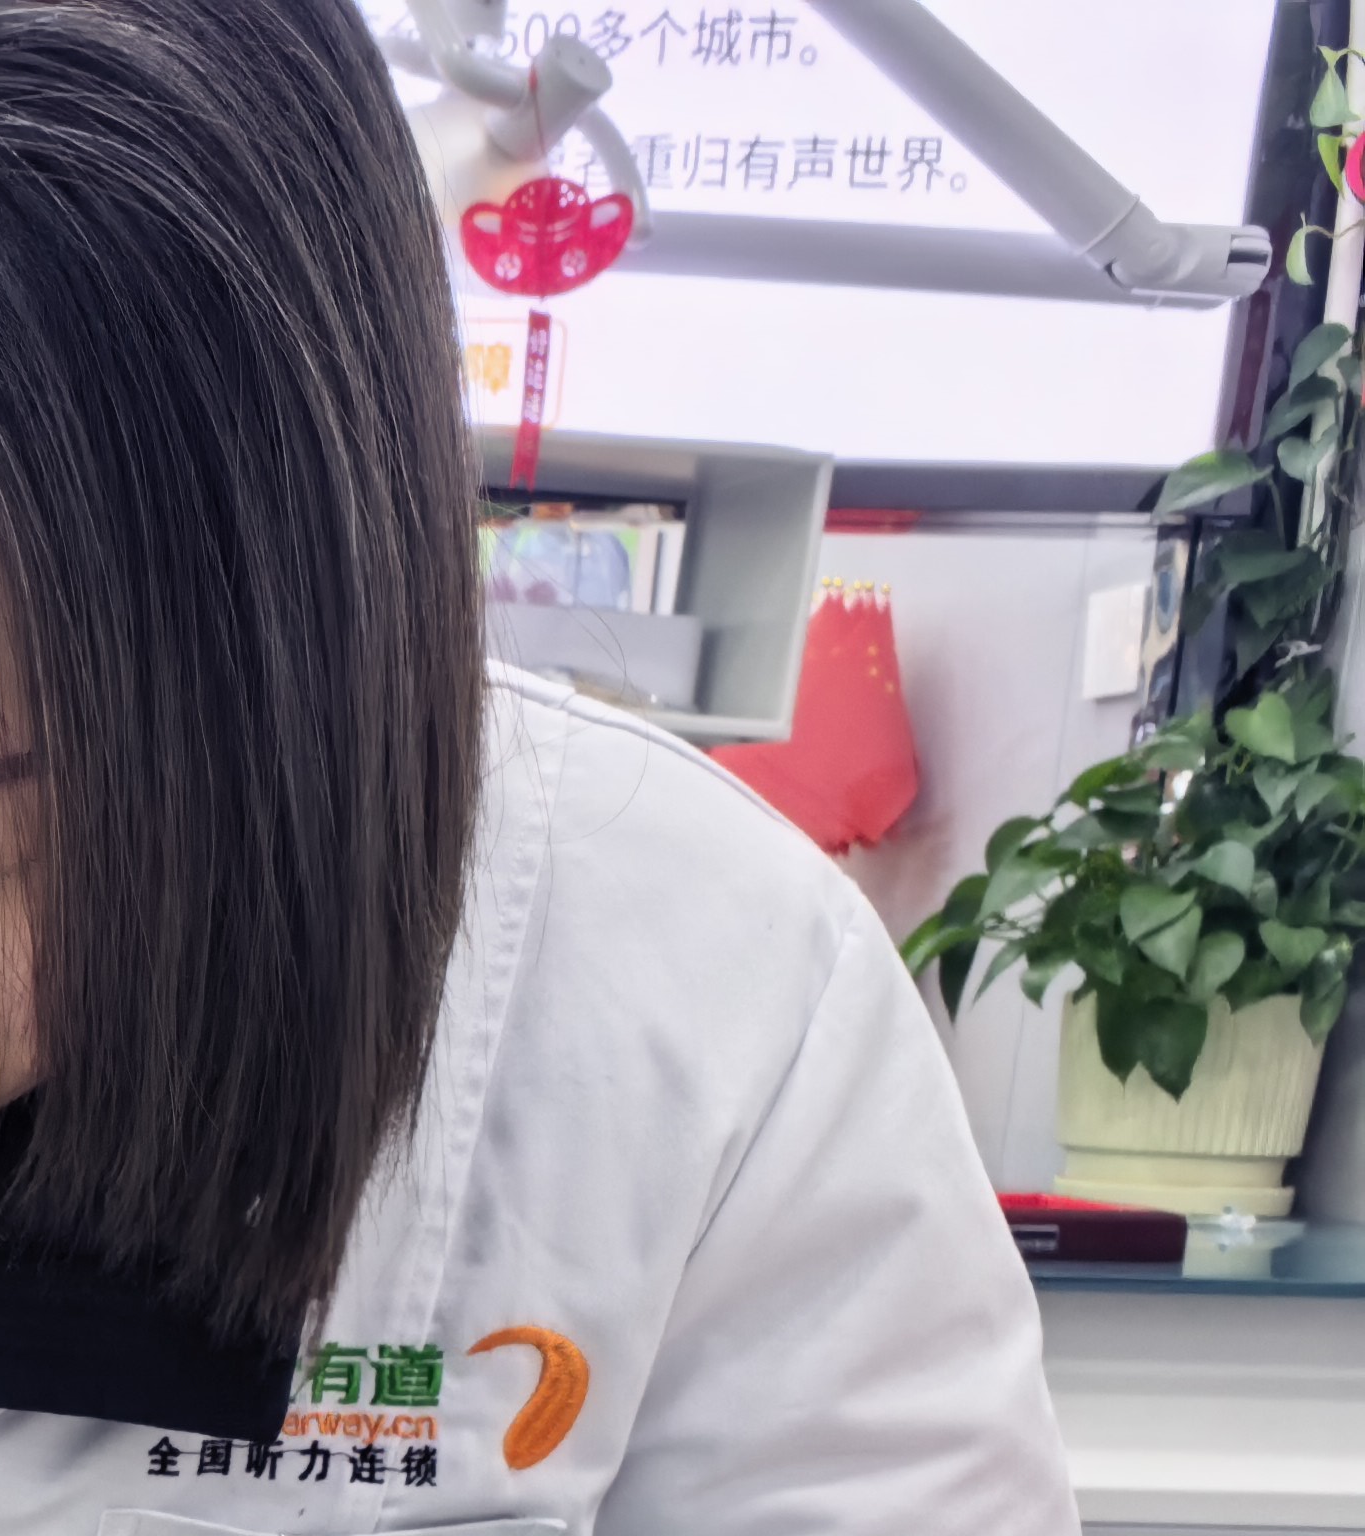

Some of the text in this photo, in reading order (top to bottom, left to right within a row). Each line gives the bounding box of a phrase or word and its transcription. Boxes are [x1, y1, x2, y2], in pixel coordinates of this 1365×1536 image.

[291, 1341, 445, 1407] 有道
[147, 1435, 438, 1487] 全国听力连锁
